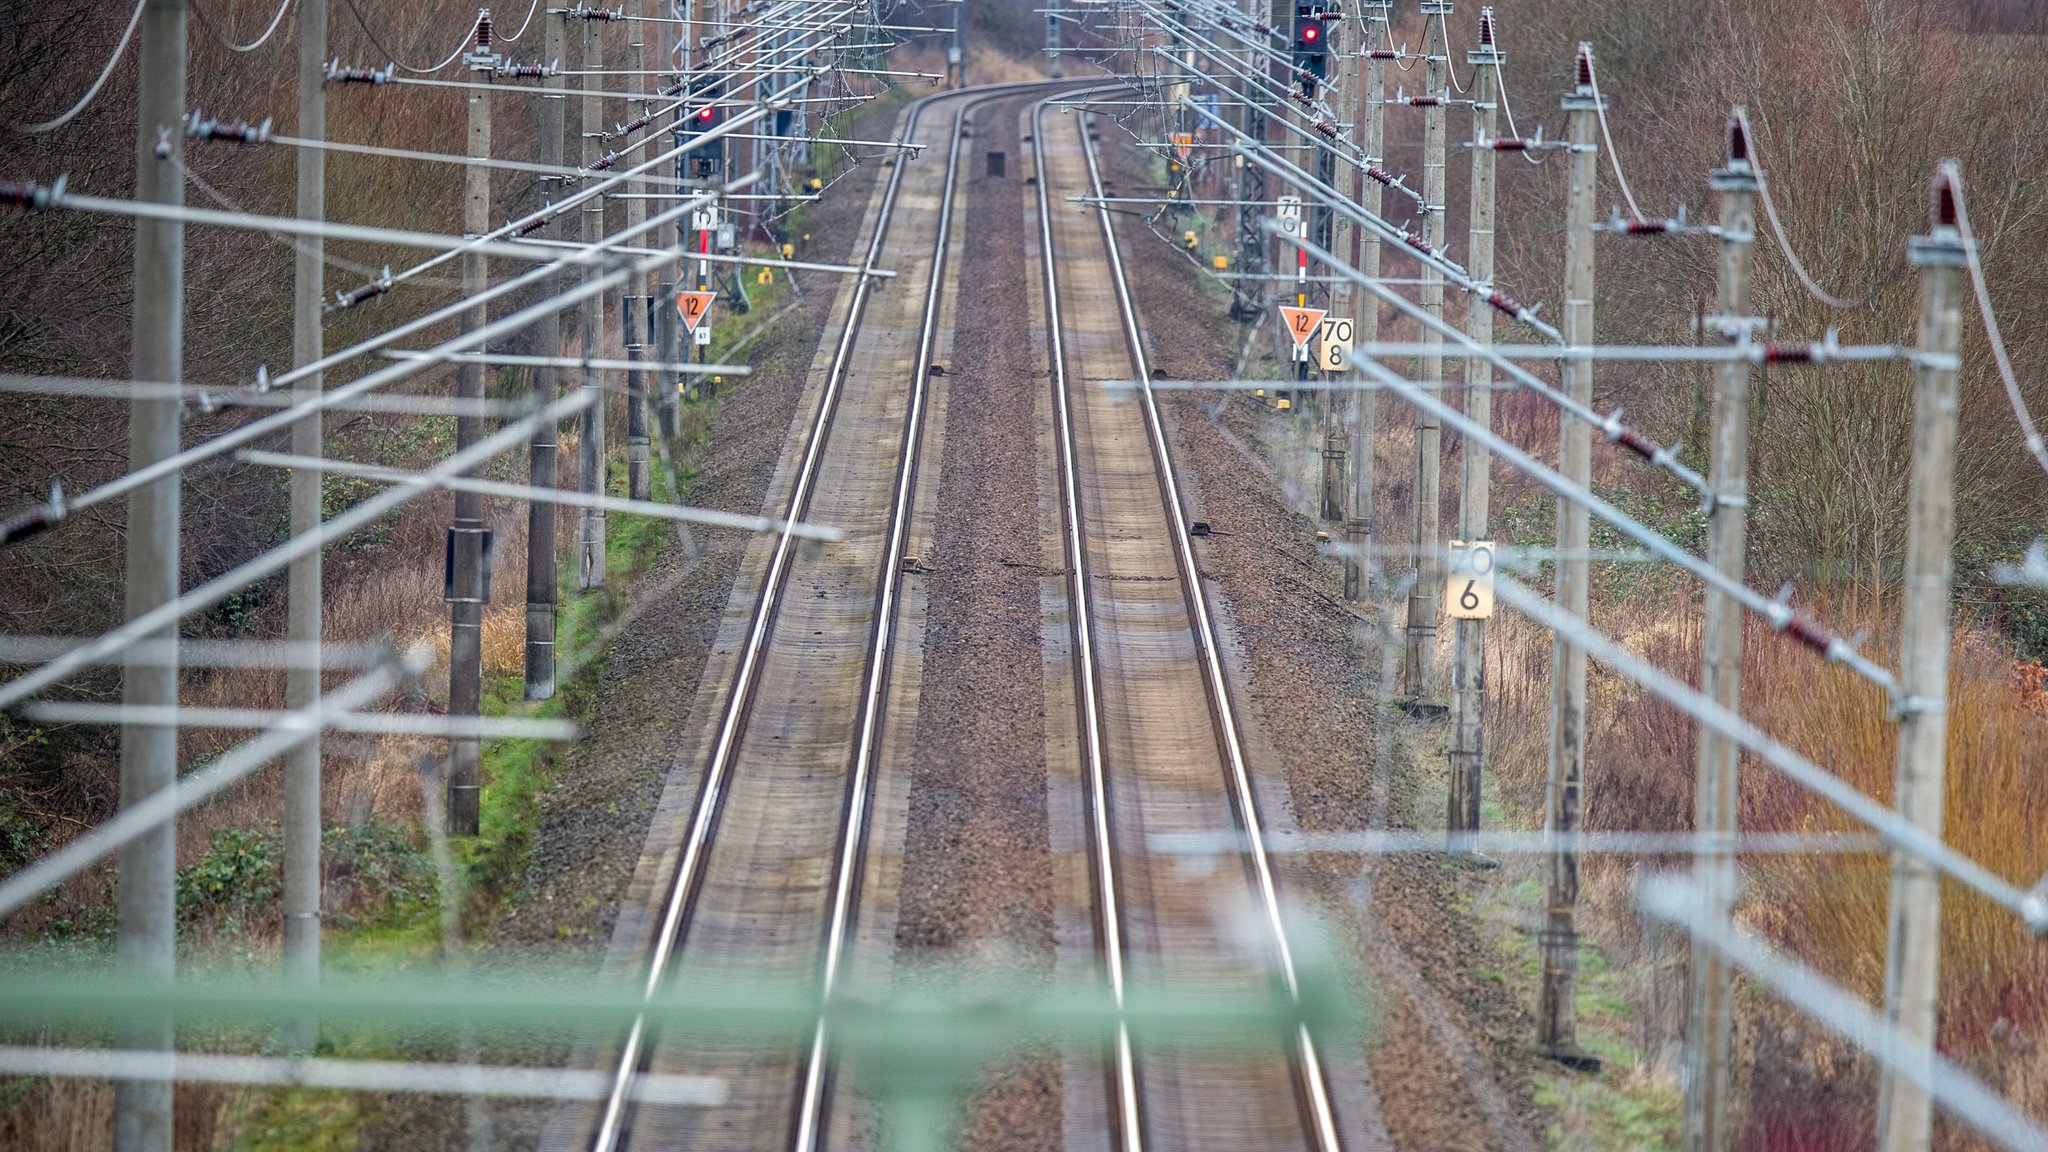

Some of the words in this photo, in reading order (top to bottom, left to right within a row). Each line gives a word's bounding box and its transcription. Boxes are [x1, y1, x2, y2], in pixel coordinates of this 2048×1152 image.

[685, 297, 699, 316] 12
[1295, 314, 1309, 332] 12
[1323, 320, 1352, 342] 70
[1329, 344, 1342, 366] 8
[1460, 579, 1479, 611] 6
